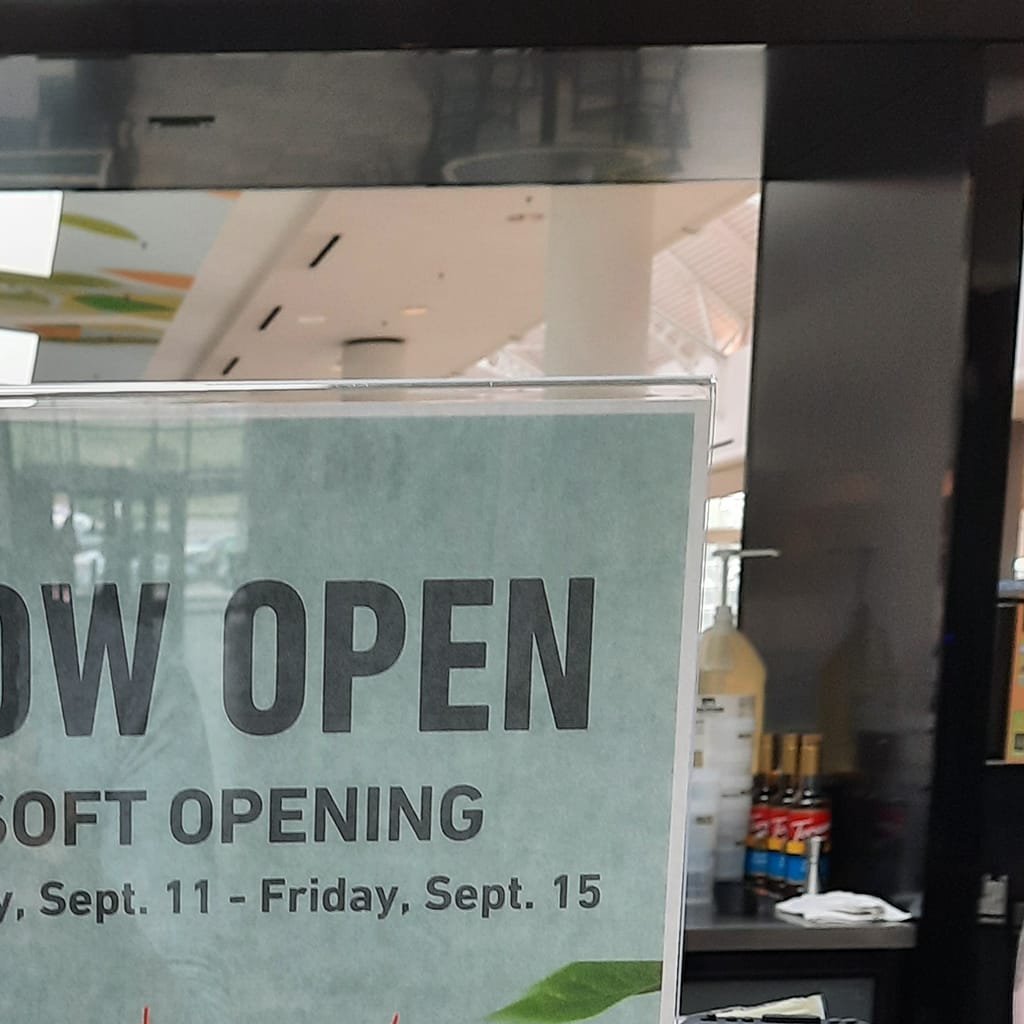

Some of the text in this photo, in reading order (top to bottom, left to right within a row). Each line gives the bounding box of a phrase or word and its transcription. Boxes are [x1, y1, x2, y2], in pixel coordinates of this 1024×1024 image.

[222, 576, 596, 736] OPEN
[169, 784, 484, 845] OPENING
[39, 880, 148, 924] Sept.
[166, 879, 210, 915] 11
[260, 877, 410, 920] Friday,
[424, 874, 535, 919] Sept.
[553, 873, 602, 910] 15
